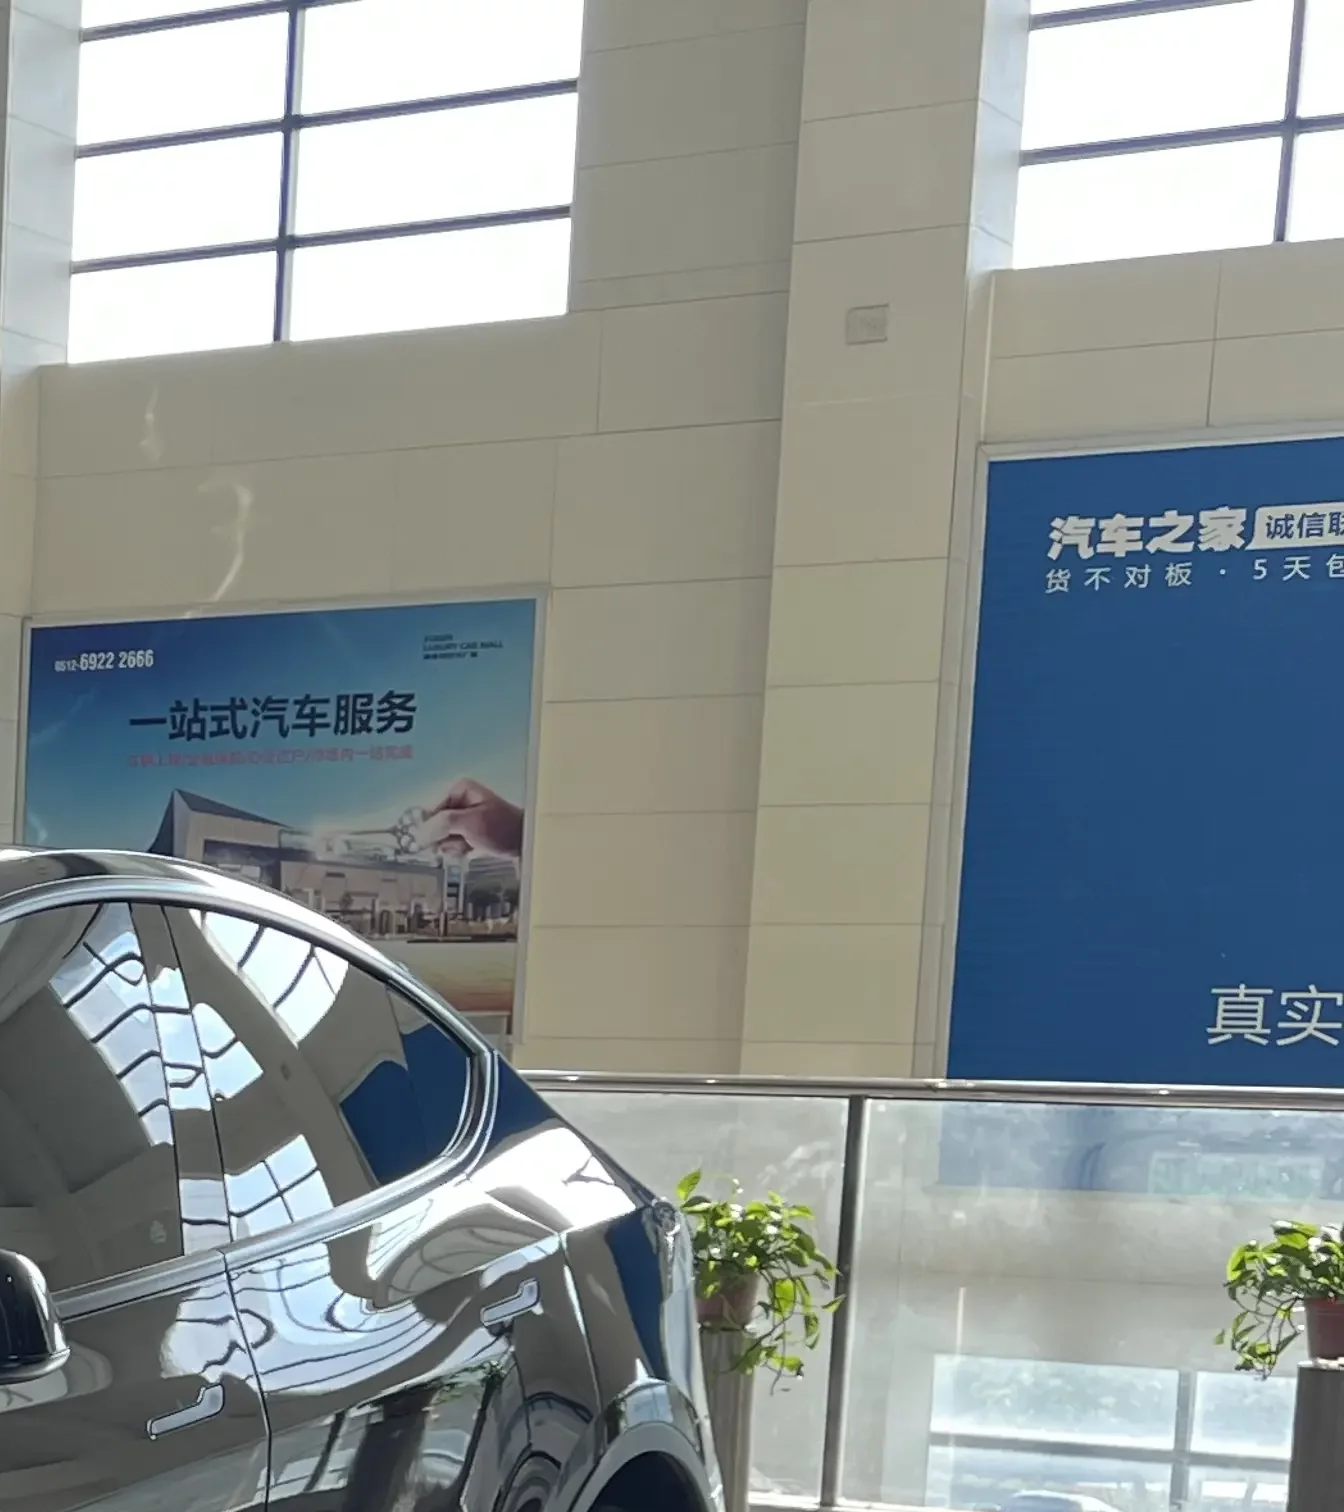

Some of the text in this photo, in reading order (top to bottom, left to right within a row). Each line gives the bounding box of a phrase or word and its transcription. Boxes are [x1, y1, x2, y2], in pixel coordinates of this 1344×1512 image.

[1047, 506, 1248, 561] 汽车之家
[129, 690, 417, 741] 一站式汽车服务
[1206, 983, 1344, 1046] 真实
